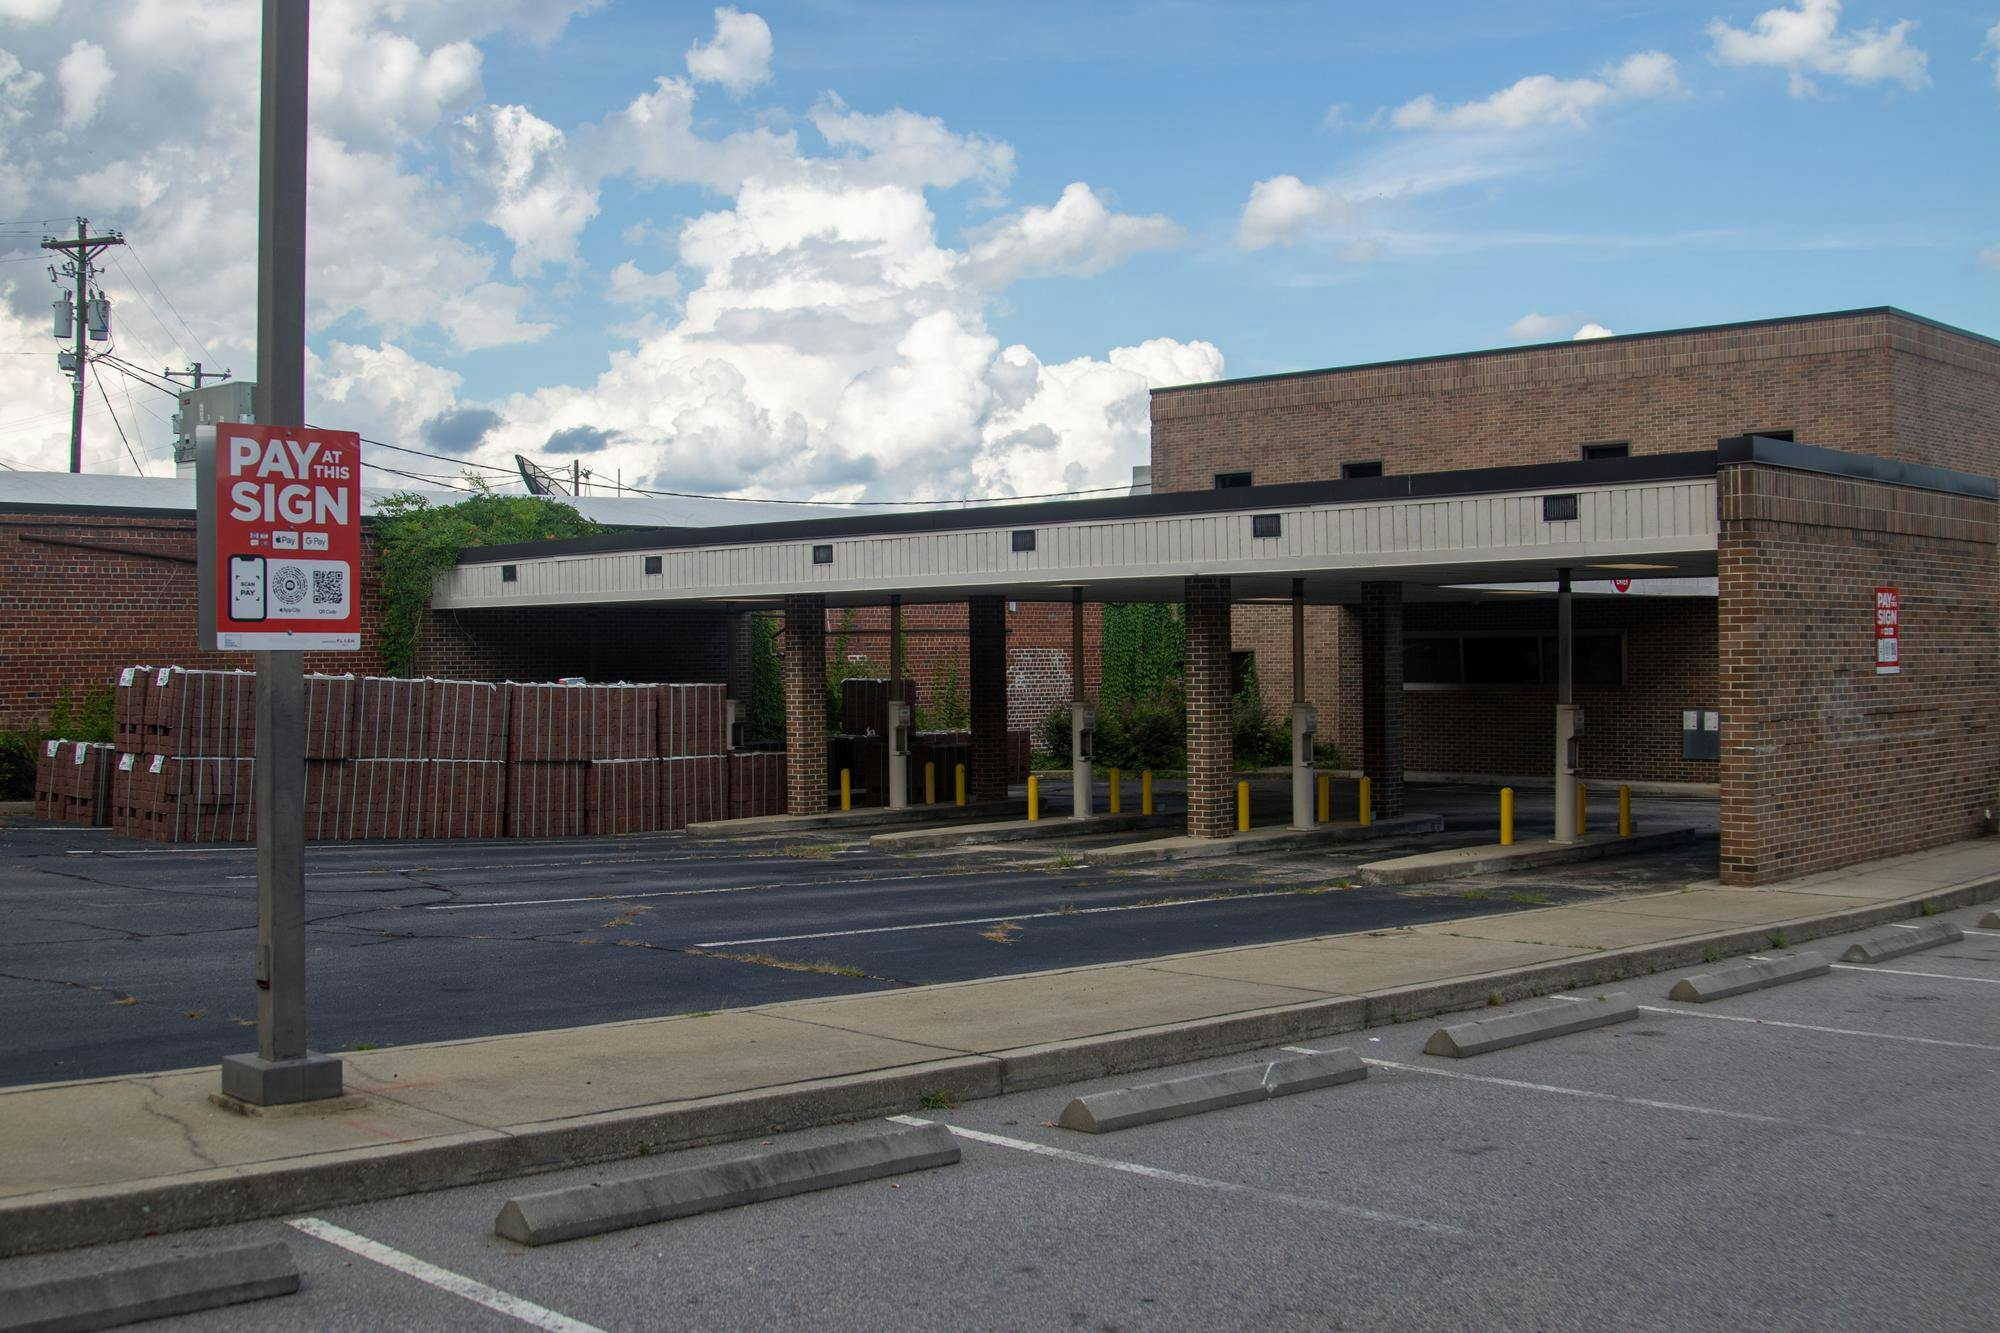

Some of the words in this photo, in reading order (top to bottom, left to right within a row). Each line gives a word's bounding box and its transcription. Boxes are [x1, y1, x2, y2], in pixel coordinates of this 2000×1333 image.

[230, 437, 321, 480] PAY
[322, 450, 342, 464] AT
[314, 465, 350, 479] THIS
[230, 481, 348, 525] SIGN
[281, 536, 296, 546] Pay
[305, 537, 313, 545] G
[313, 537, 326, 547] Pay
[1877, 592, 1892, 608] PAY
[1878, 609, 1897, 625] SIGN
